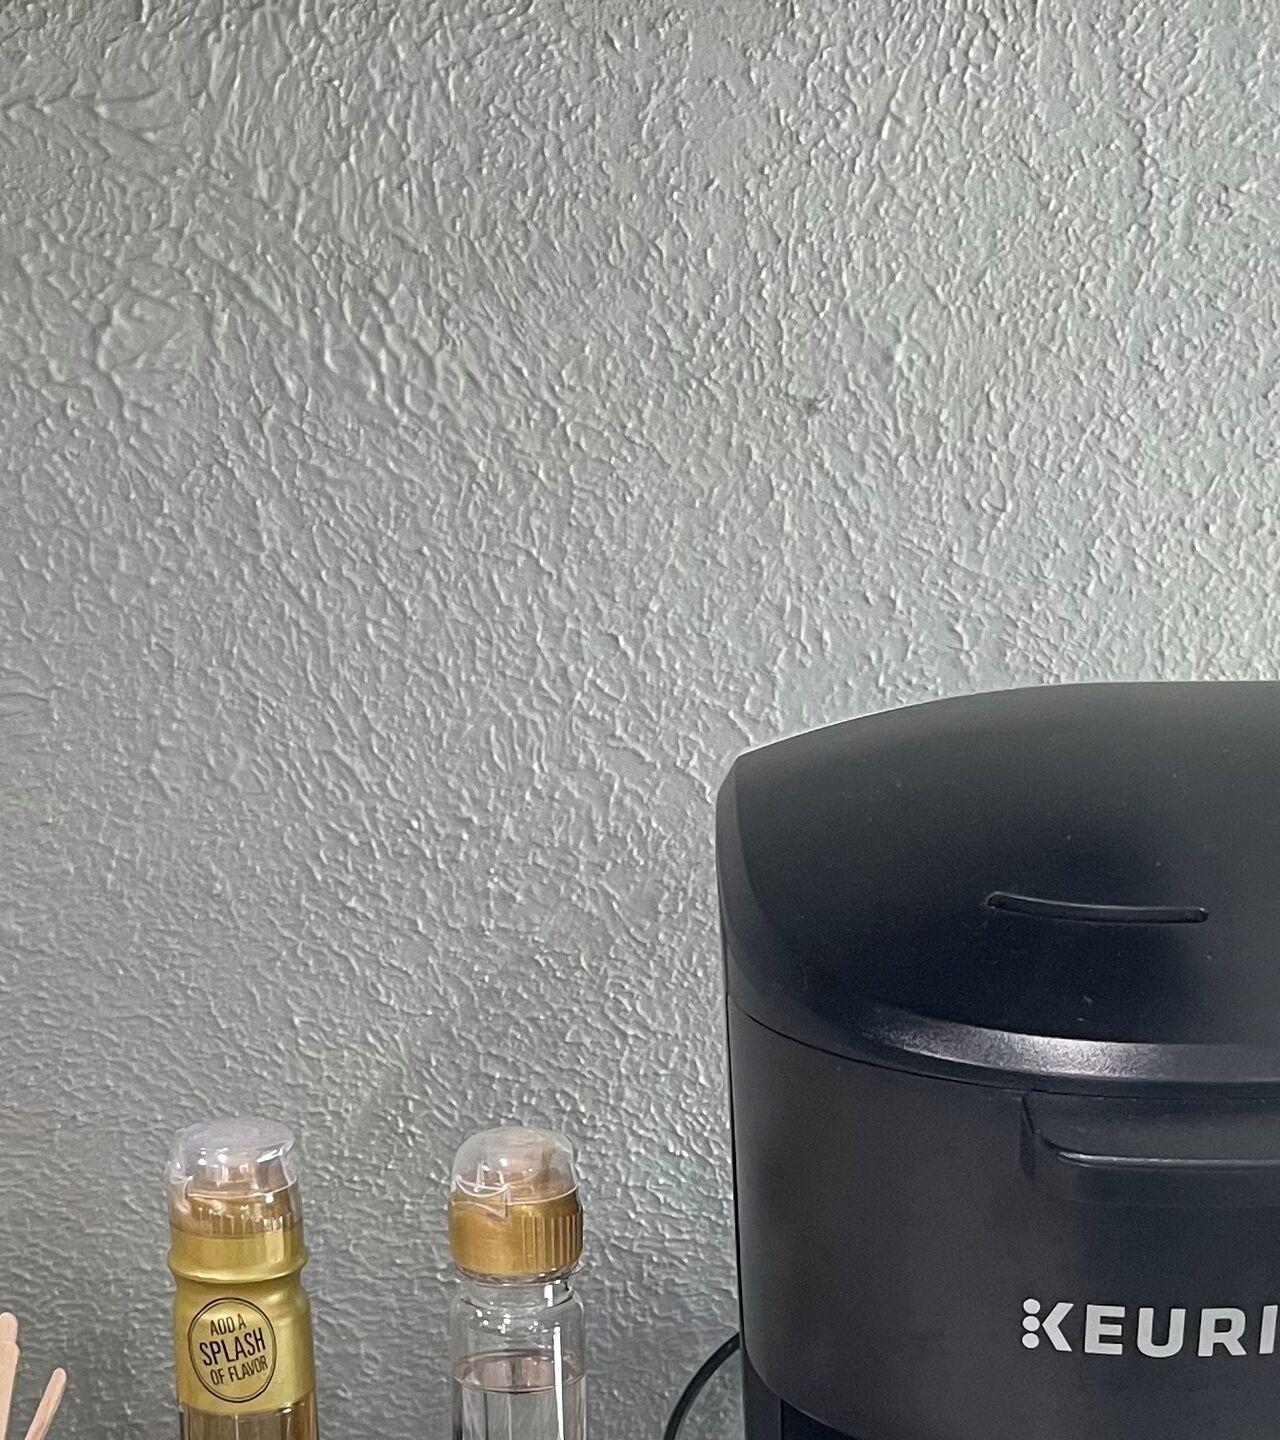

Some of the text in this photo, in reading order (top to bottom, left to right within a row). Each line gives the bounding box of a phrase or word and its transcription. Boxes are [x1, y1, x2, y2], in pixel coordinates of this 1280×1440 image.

[210, 1313, 247, 1337] ADD A
[199, 1326, 267, 1366] SPLASH
[209, 1355, 269, 1386] OF FLAVOR
